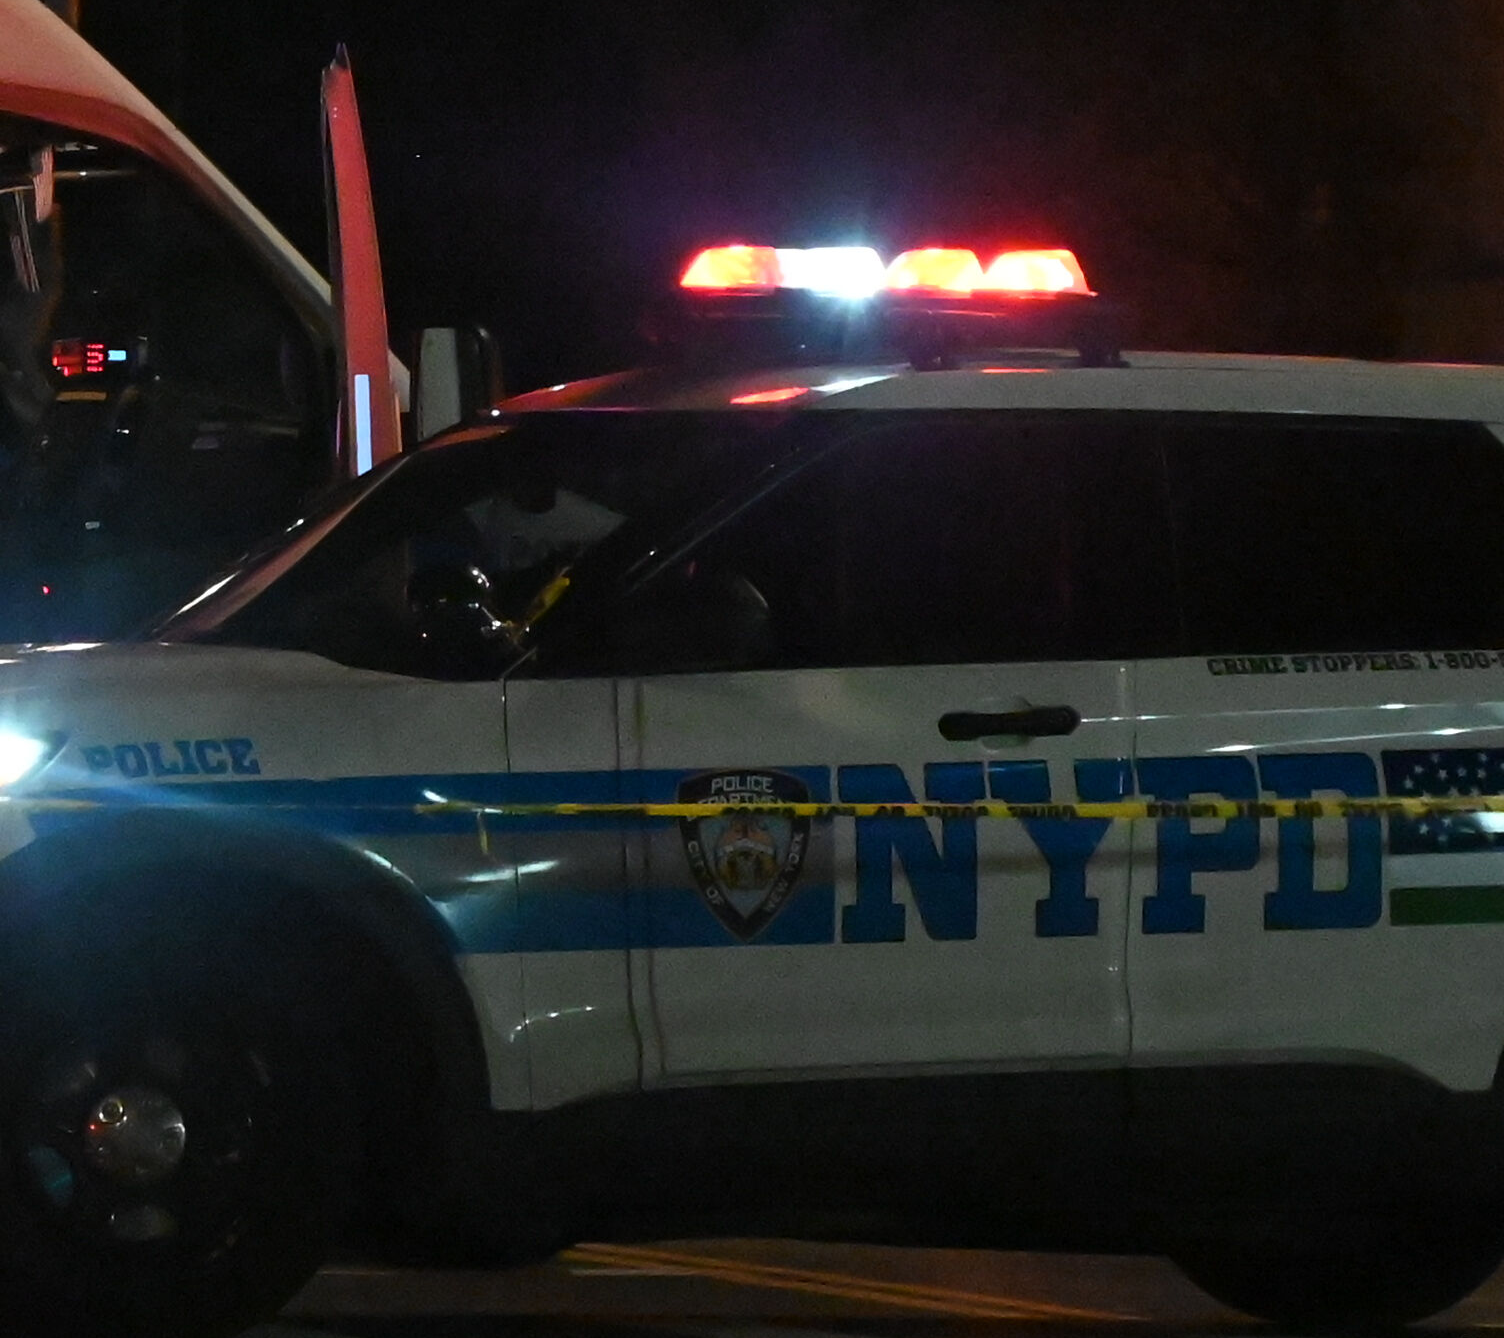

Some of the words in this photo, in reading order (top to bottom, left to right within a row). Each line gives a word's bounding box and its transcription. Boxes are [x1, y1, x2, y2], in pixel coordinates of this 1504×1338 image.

[1207, 655, 1289, 677] CRIME
[81, 738, 262, 778] POLICE
[710, 775, 775, 795] POLICE
[837, 752, 1384, 944] NYPD
